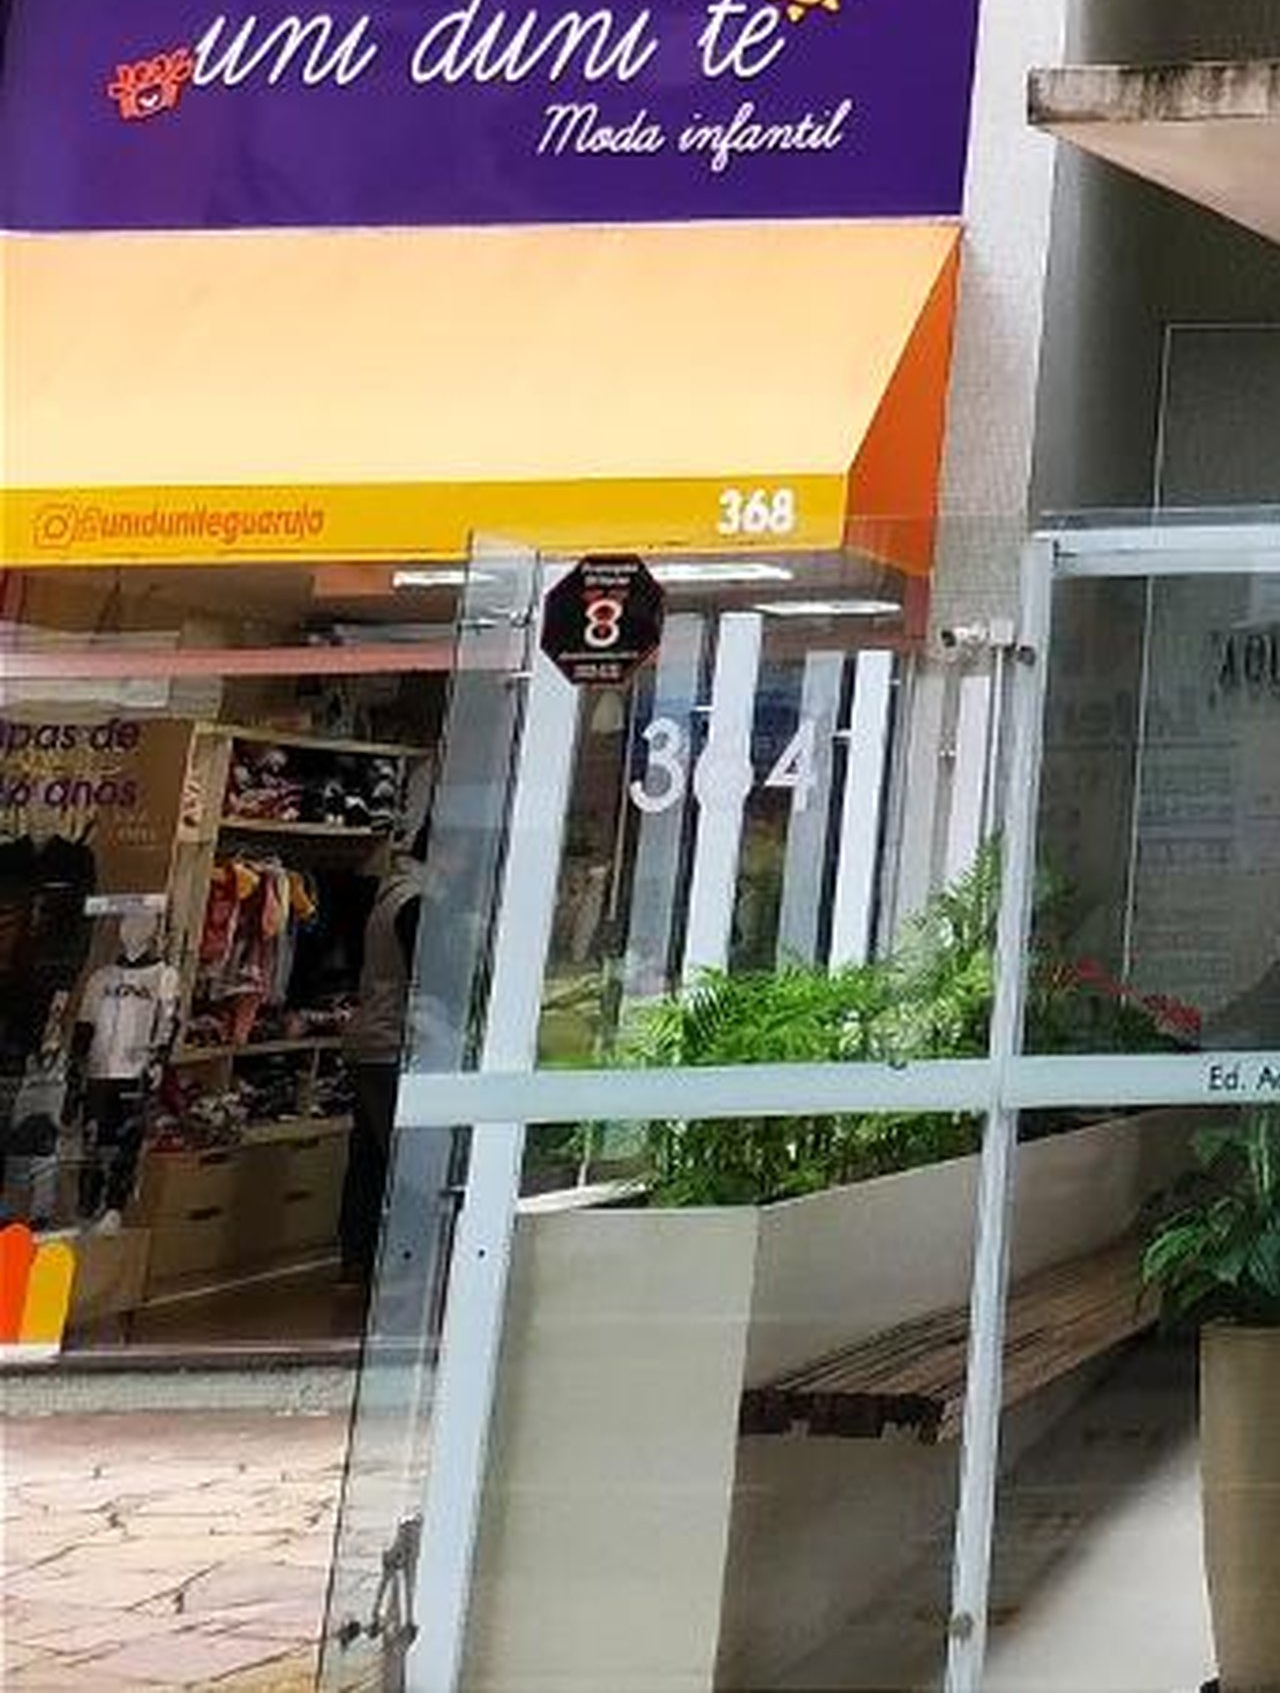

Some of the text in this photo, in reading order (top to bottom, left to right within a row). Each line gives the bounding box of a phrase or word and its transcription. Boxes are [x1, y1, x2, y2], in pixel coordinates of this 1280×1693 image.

[537, 99, 852, 172] Moda infantil
[717, 487, 794, 534] 368
[90, 717, 139, 749] de
[45, 778, 138, 807] anos
[1208, 1066, 1246, 1091] Ed.
